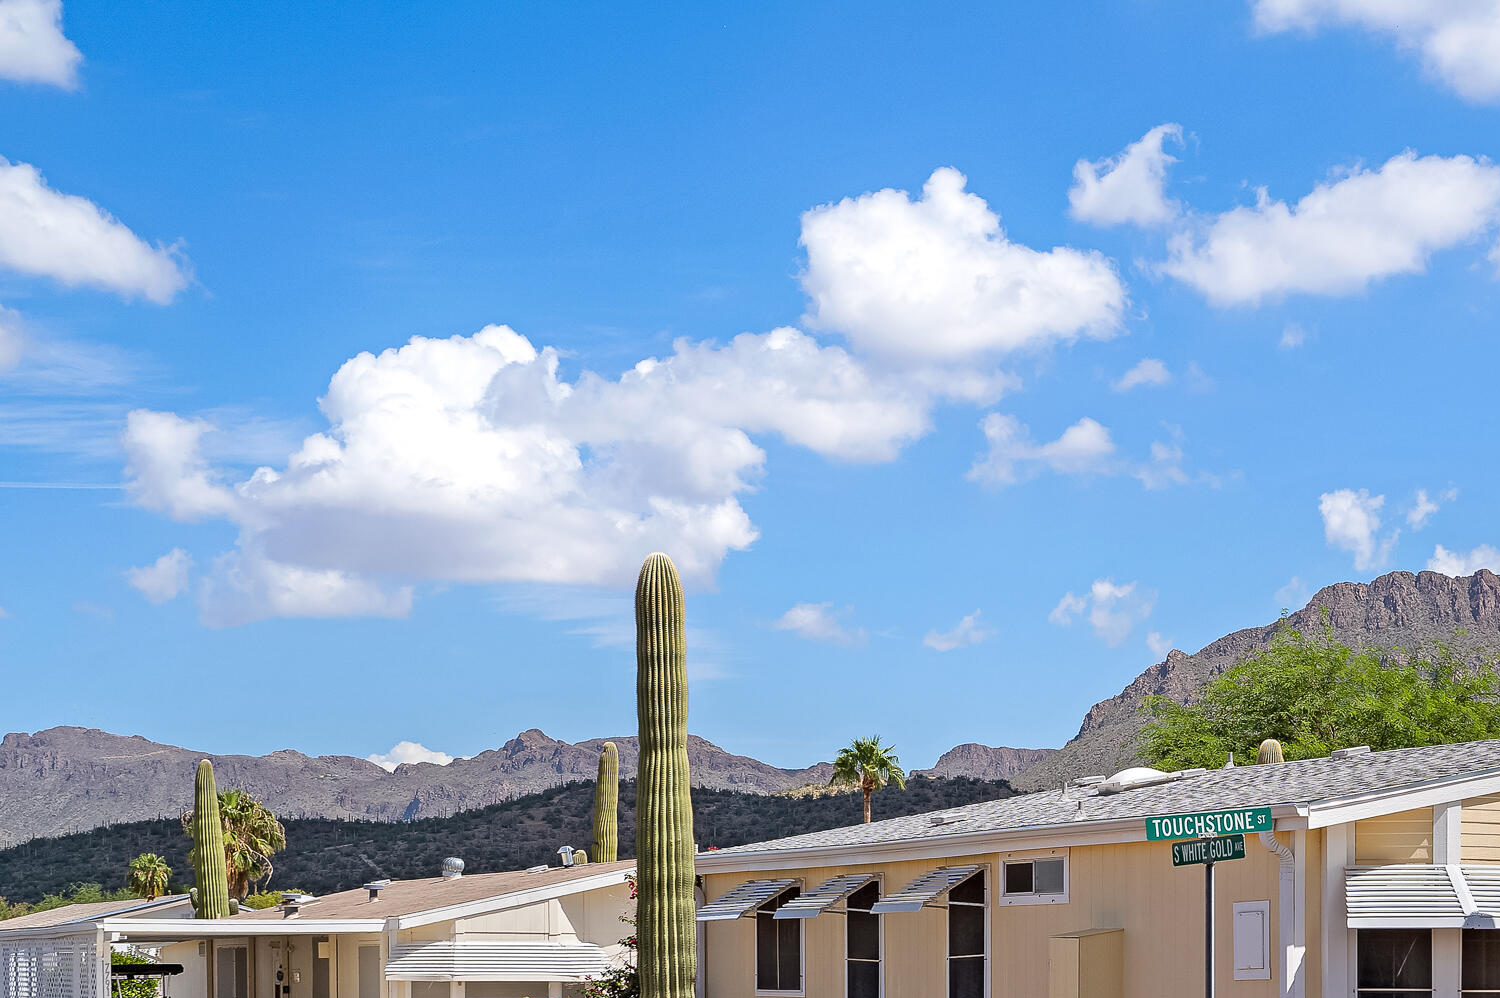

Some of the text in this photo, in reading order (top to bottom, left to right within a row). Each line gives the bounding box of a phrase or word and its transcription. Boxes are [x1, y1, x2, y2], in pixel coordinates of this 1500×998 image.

[1152, 811, 1266, 838] TOUCHSTONE ST
[1174, 845, 1180, 863] S
[1181, 842, 1207, 862] WHITE
[1209, 839, 1233, 858] GOLD
